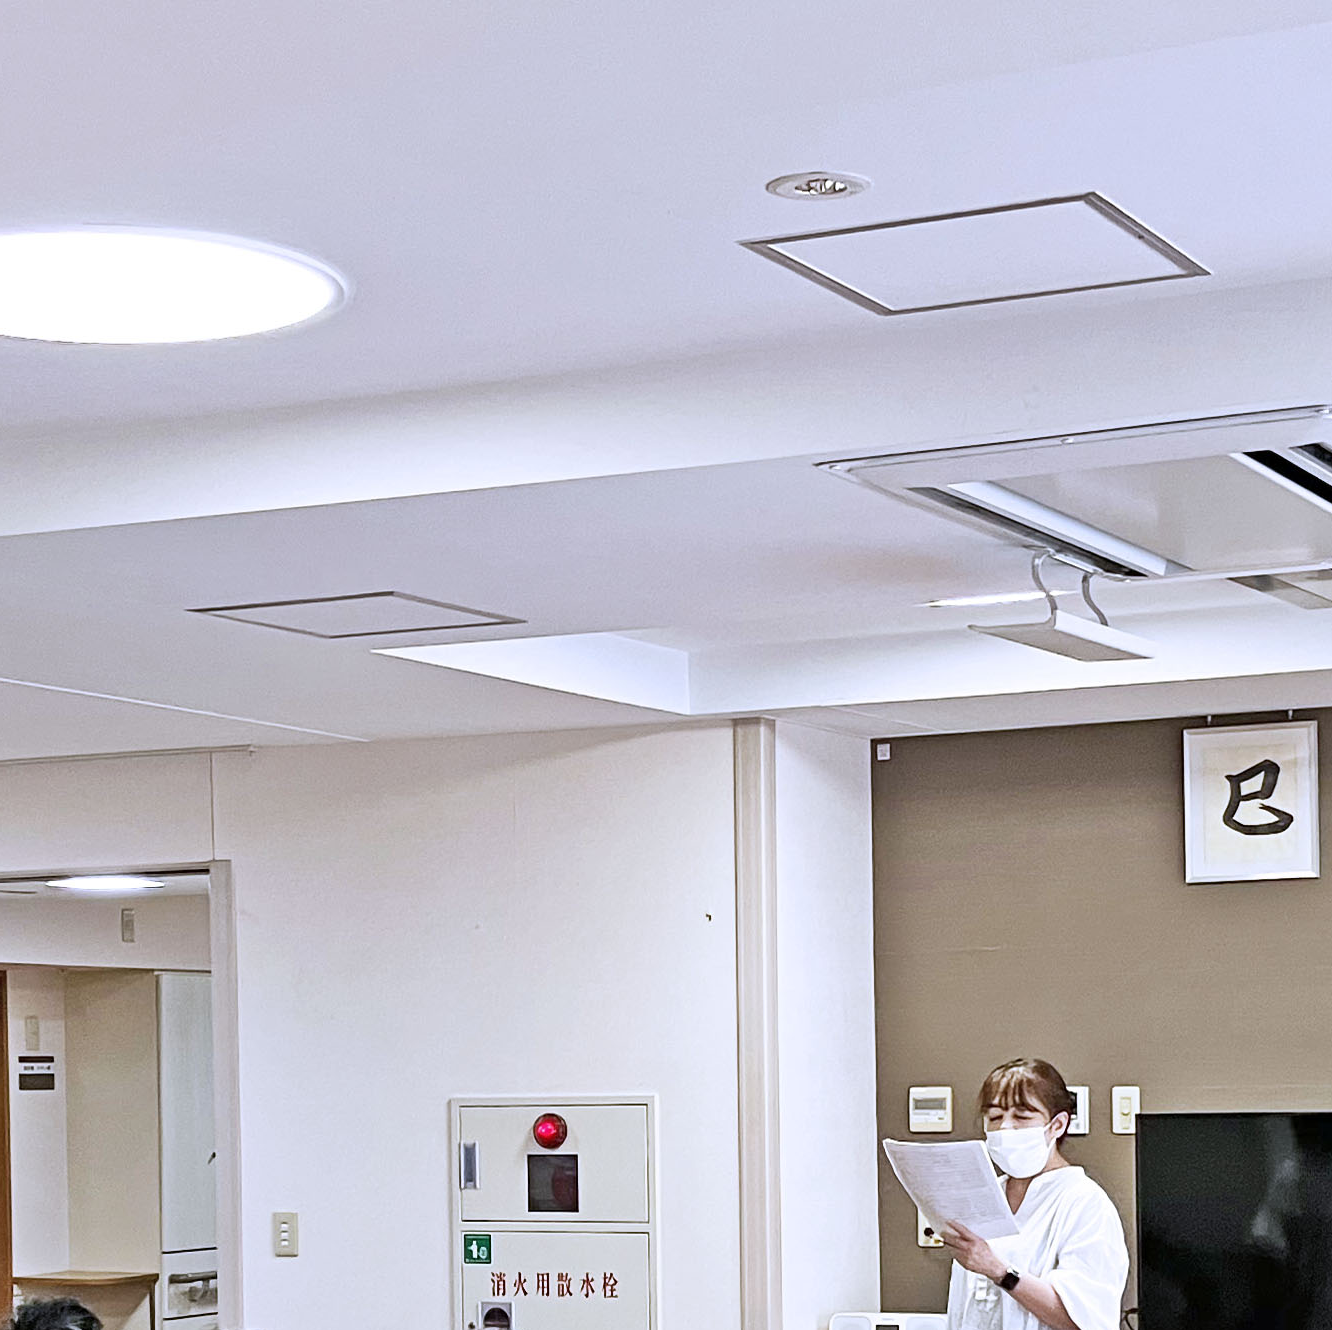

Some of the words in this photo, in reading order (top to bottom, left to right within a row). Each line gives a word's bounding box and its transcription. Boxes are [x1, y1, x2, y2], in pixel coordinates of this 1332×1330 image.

[490, 1271, 619, 1299] 消火用散水栓
